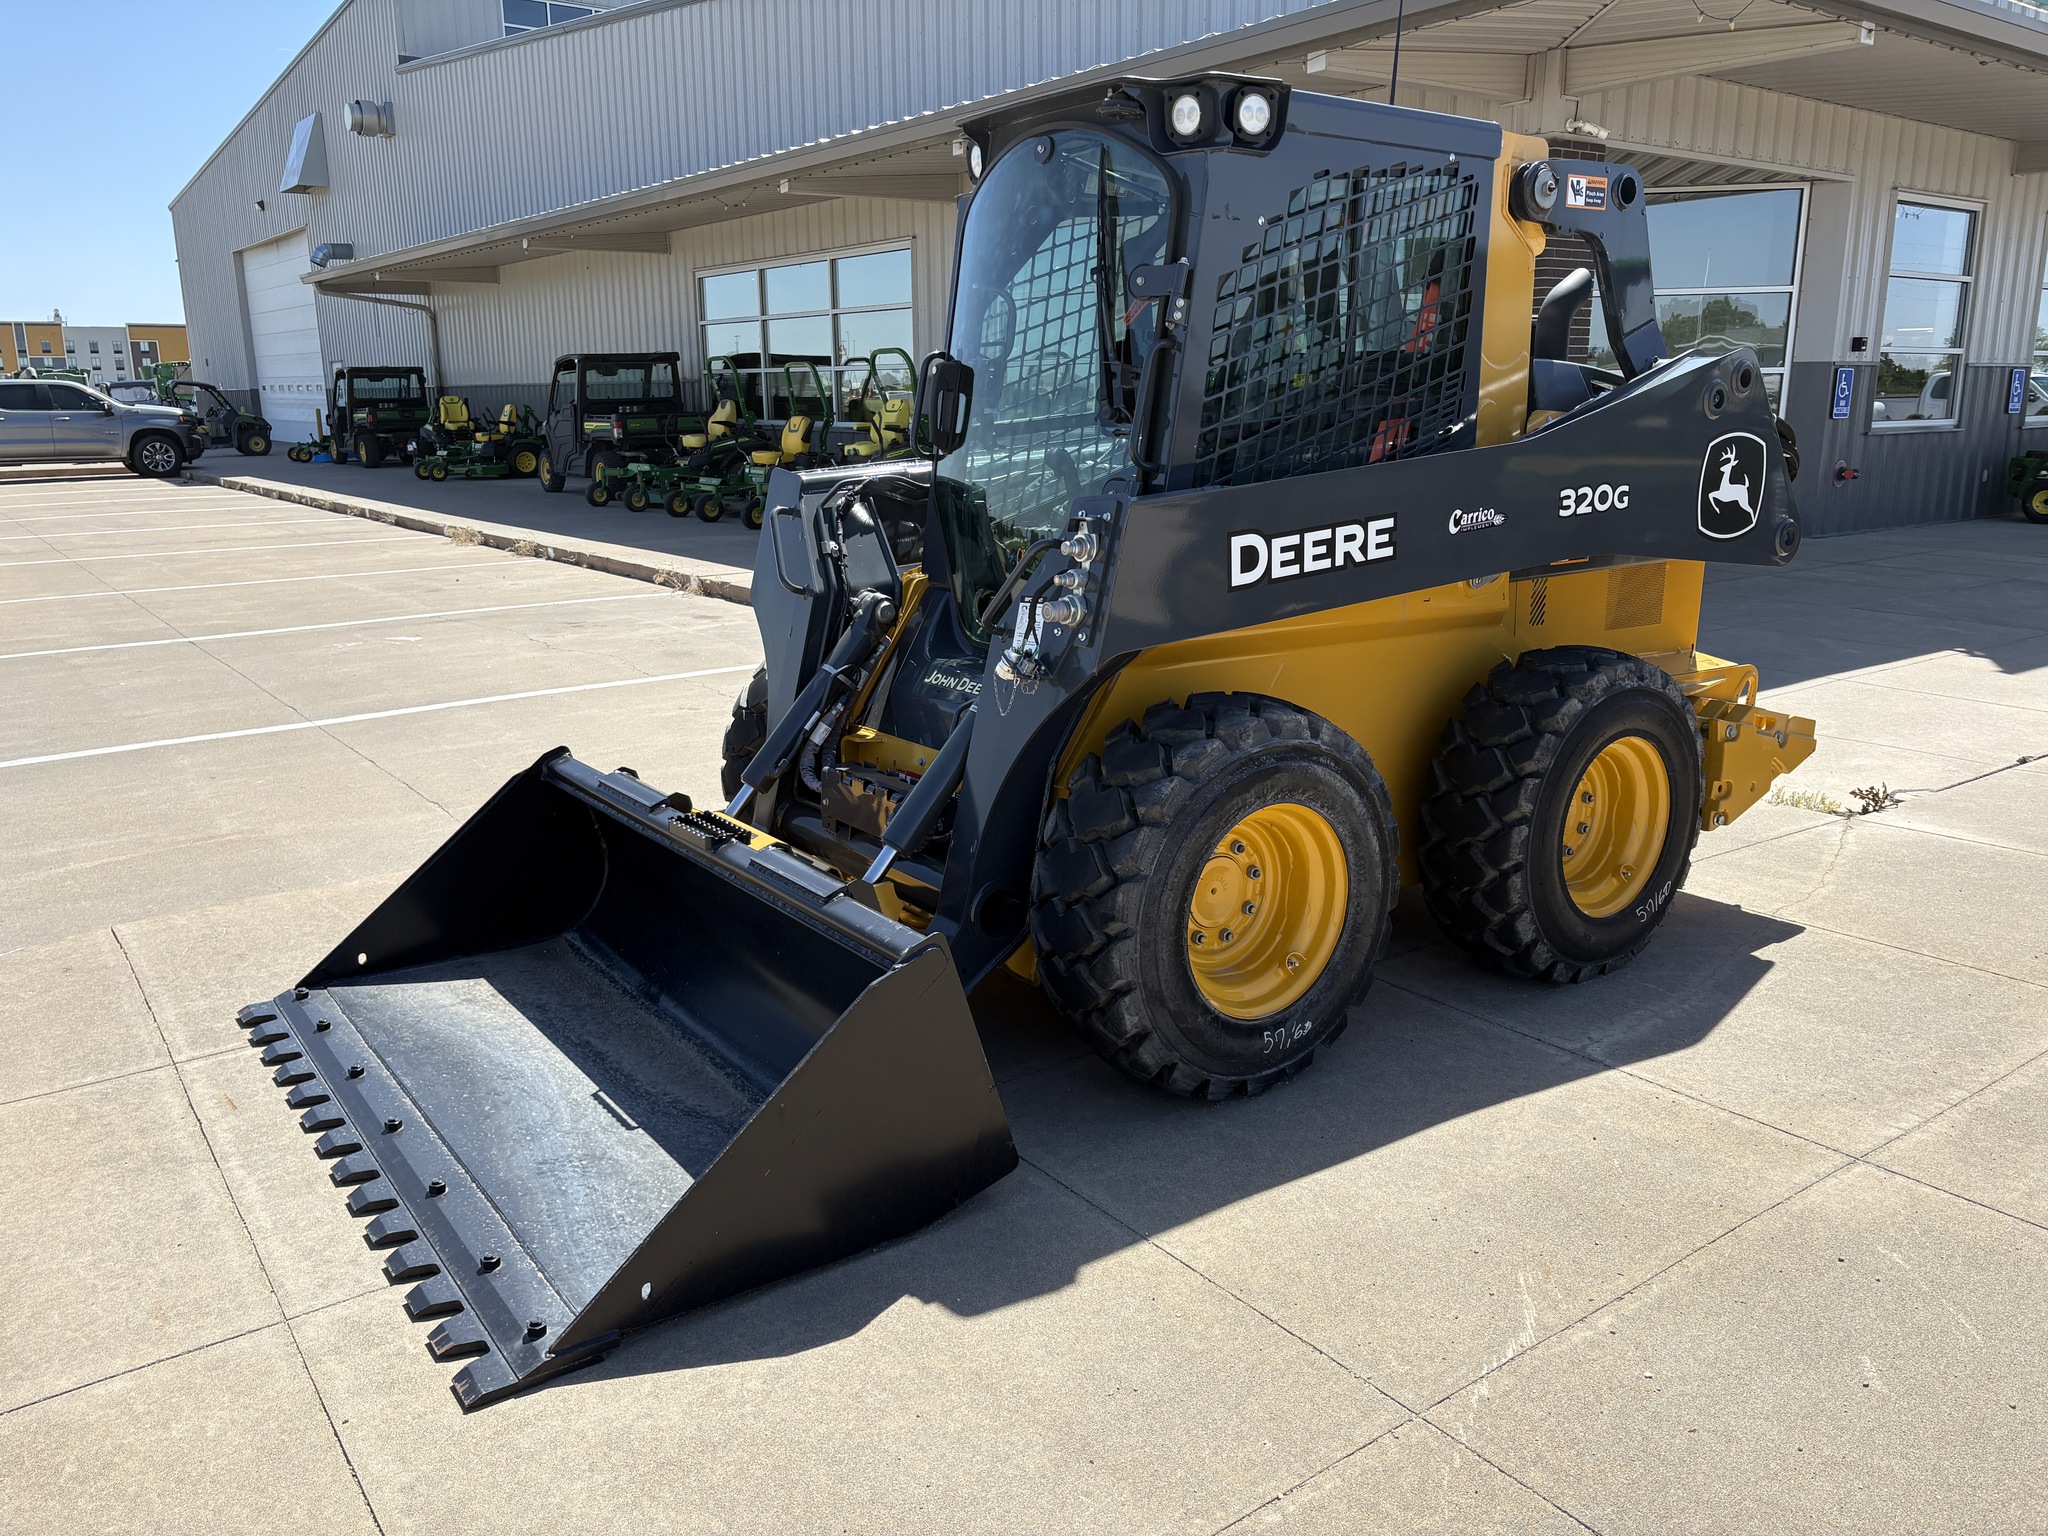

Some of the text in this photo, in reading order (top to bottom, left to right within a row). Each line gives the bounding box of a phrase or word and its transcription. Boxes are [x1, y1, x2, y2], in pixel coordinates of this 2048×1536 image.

[1559, 484, 1630, 517] 320G
[1449, 507, 1495, 535] Carrico
[1461, 522, 1492, 532] IMPLEMENT
[1231, 517, 1395, 587] DEERE
[924, 670, 983, 695] JOHN DEE
